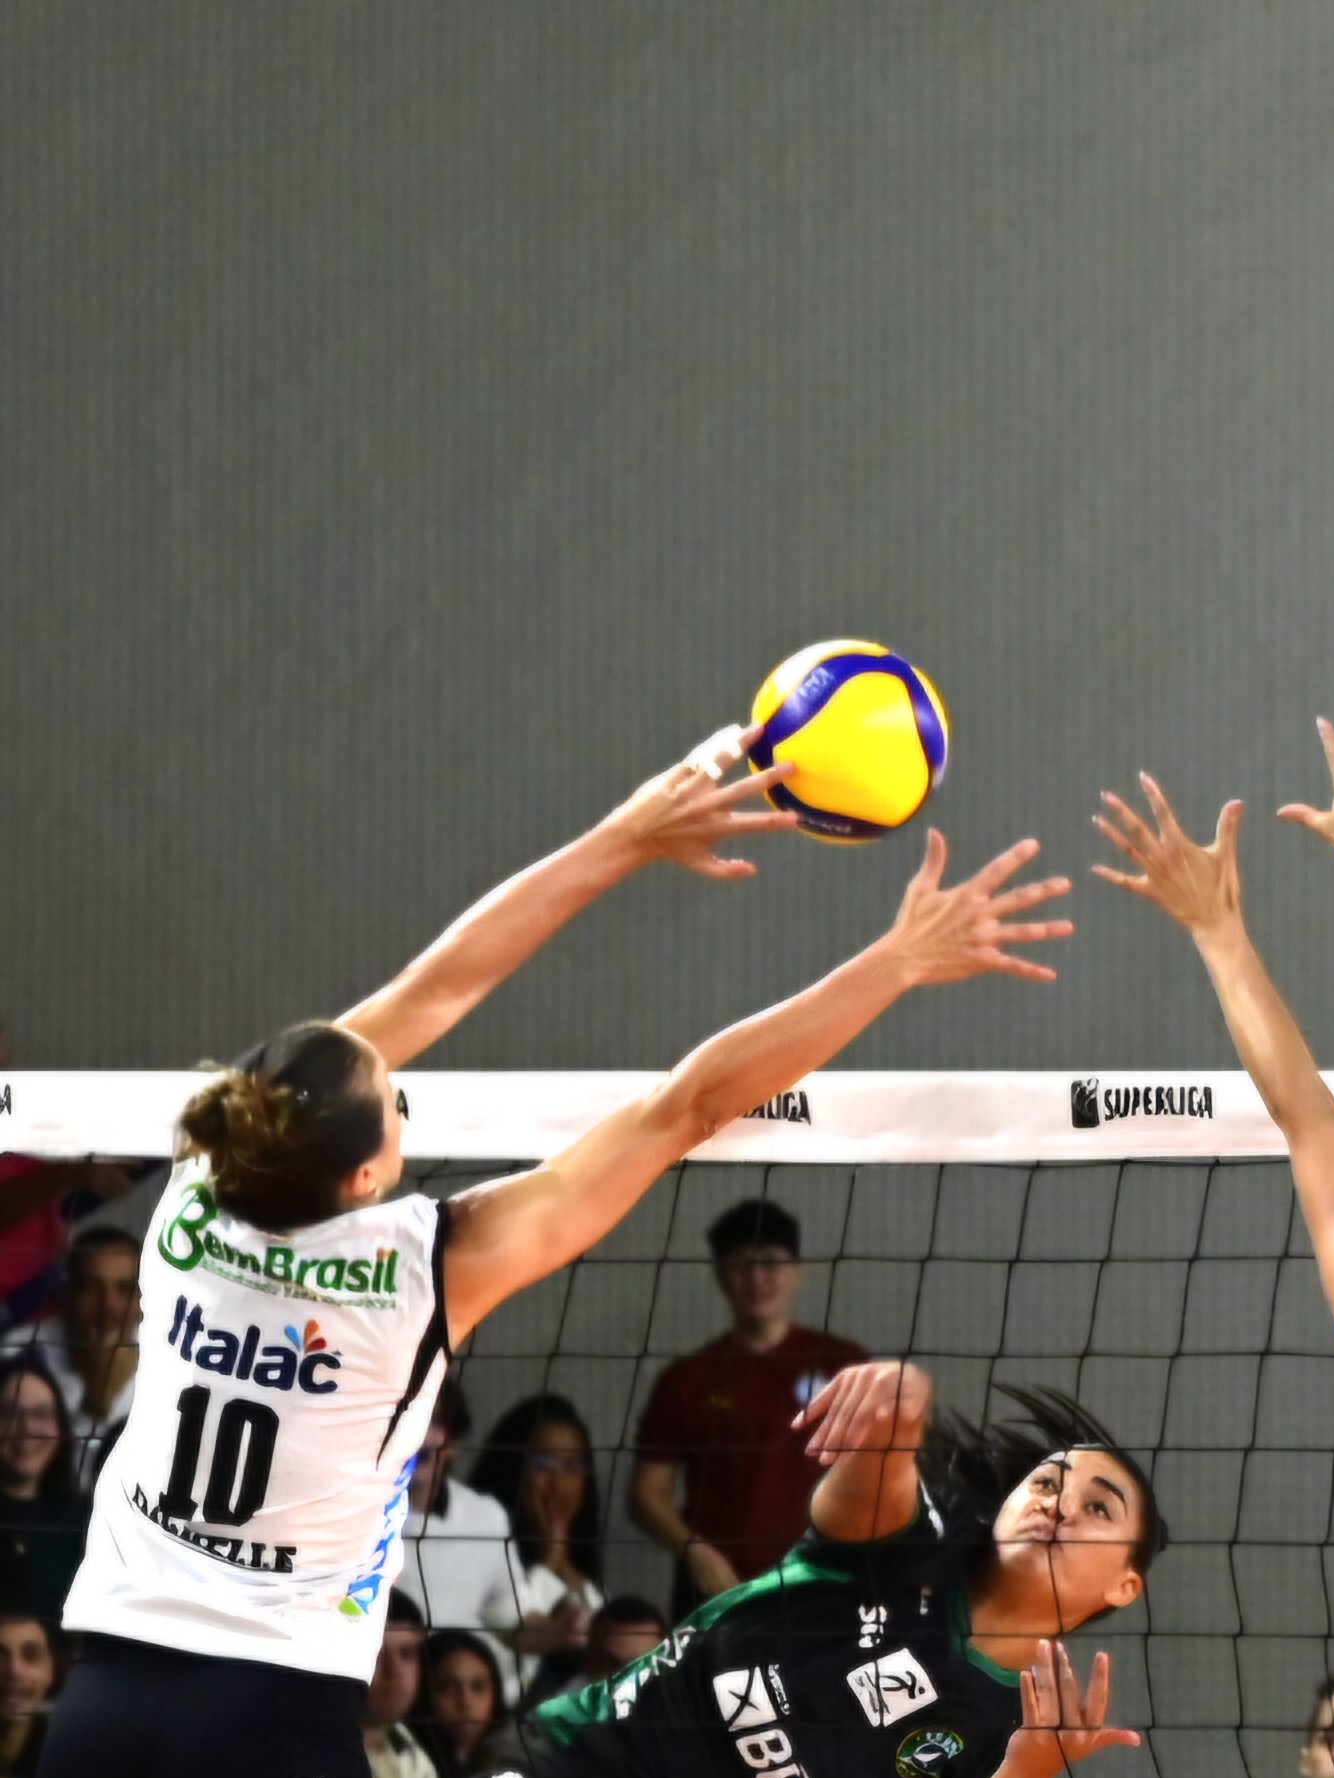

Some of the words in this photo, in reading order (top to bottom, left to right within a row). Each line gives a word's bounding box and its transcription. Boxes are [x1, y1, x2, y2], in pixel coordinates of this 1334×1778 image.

[1104, 1086, 1213, 1121] SUPERLIGA
[167, 1294, 342, 1394] Italac
[160, 1384, 280, 1526] 10
